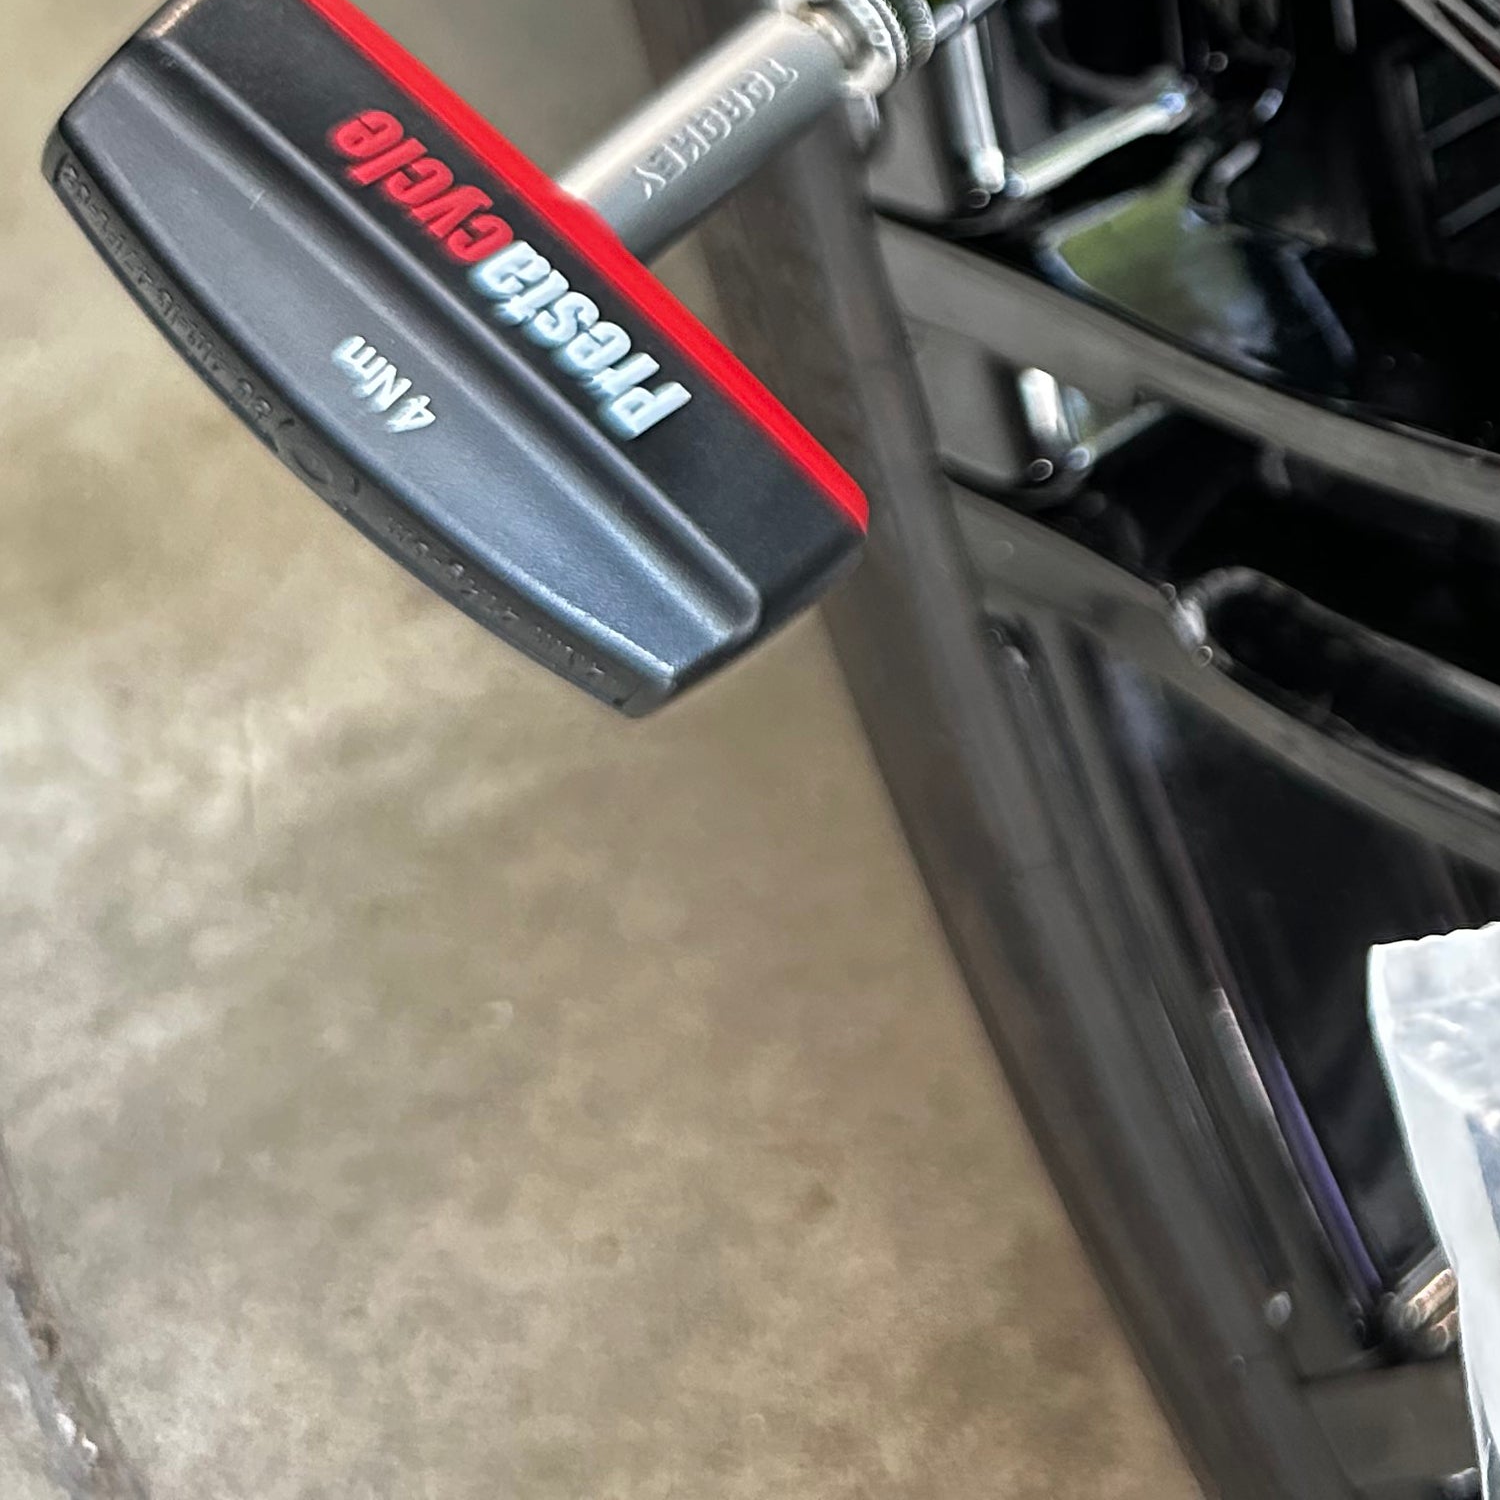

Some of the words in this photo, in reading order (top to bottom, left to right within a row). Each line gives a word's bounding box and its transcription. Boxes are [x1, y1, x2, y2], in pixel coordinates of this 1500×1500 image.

[331, 108, 692, 441] Prestacycle
[331, 335, 413, 413] Nm
[384, 394, 436, 434] 4
